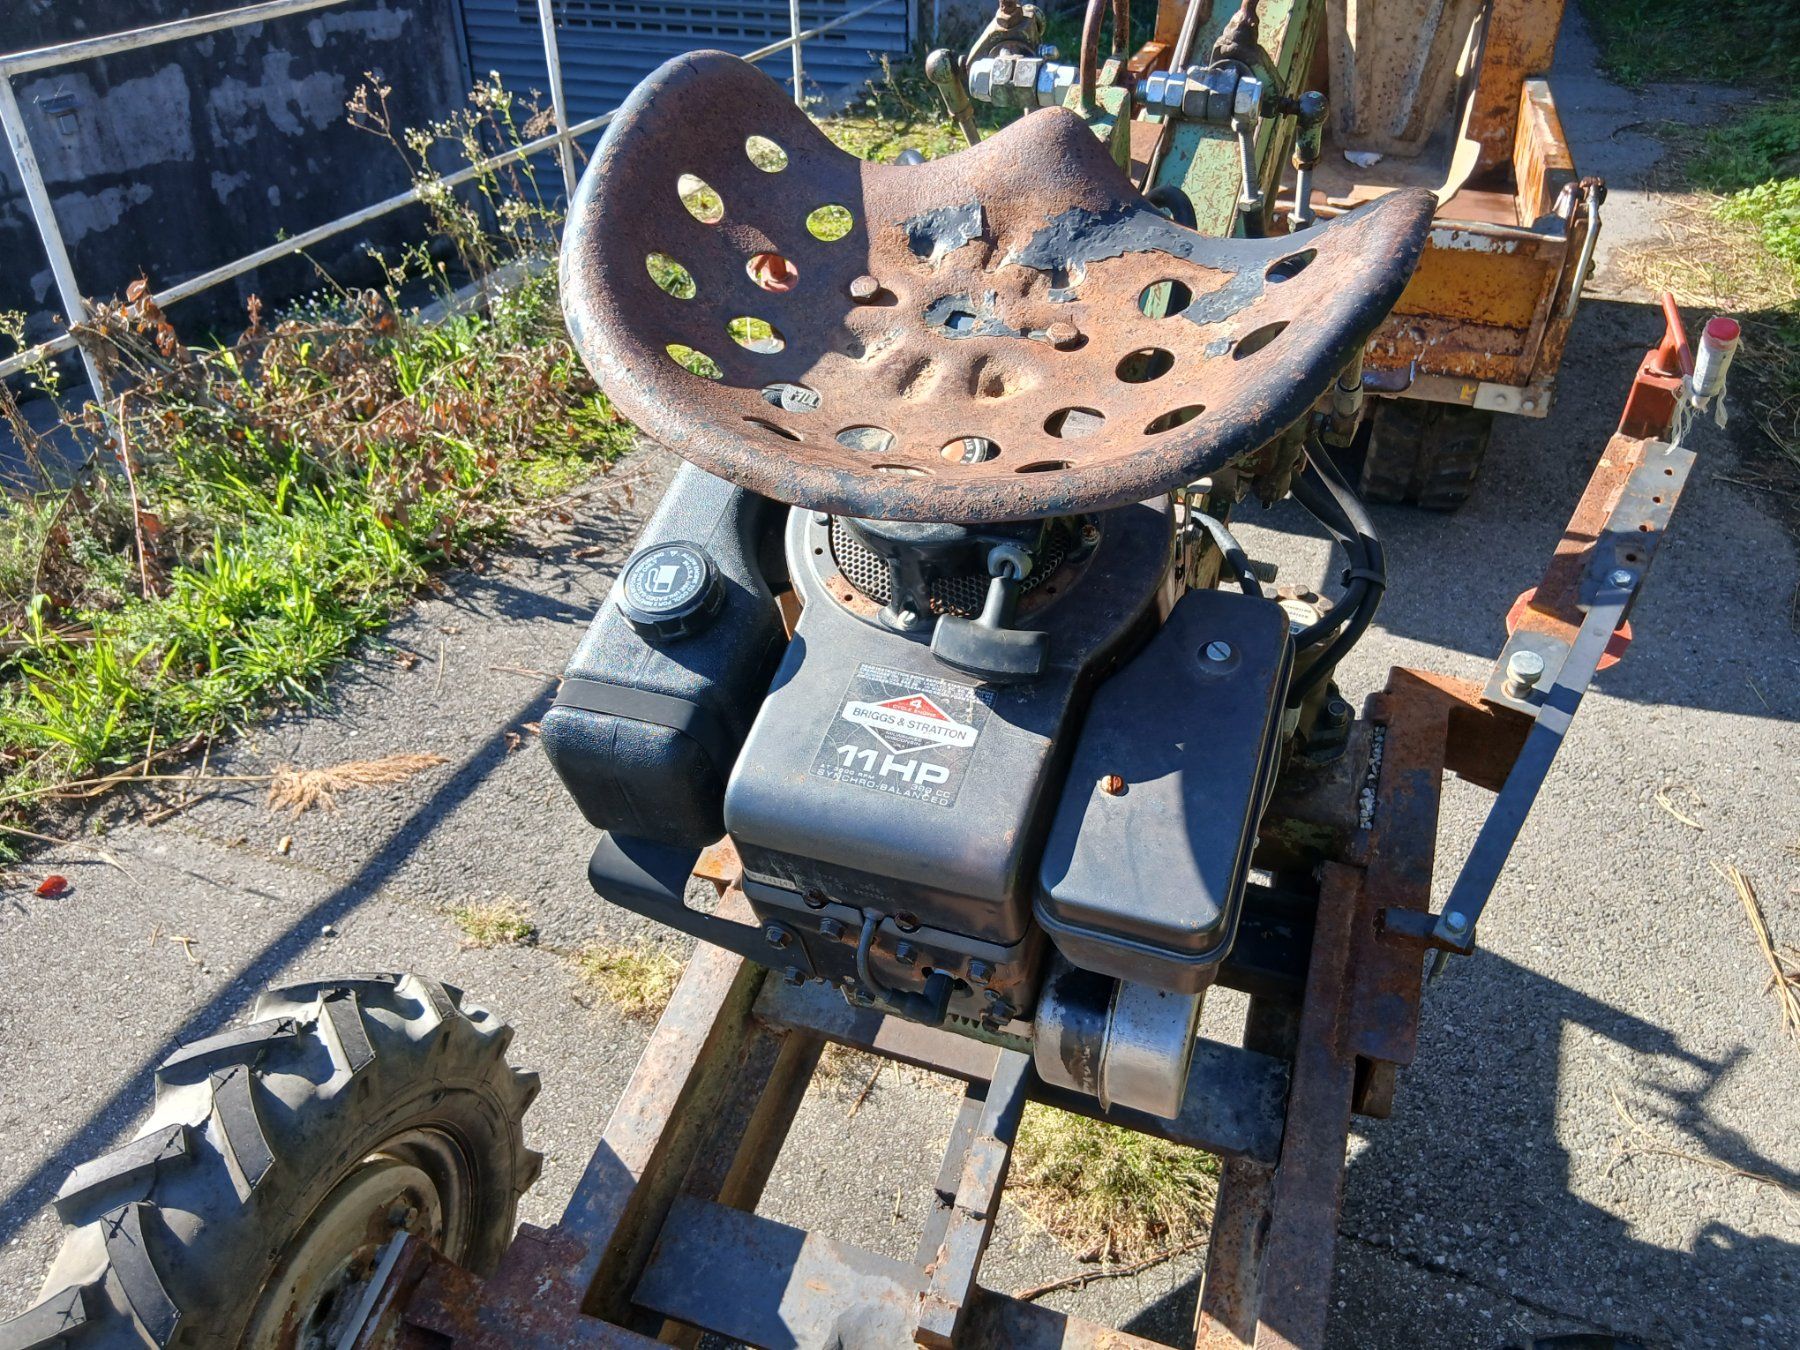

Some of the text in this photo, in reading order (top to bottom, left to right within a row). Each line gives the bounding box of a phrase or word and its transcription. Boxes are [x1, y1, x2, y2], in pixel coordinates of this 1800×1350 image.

[910, 699, 922, 709] 4
[852, 707, 967, 741] BRIGGS & STRATTON
[857, 772, 875, 780] RPM
[936, 789, 951, 799] CC
